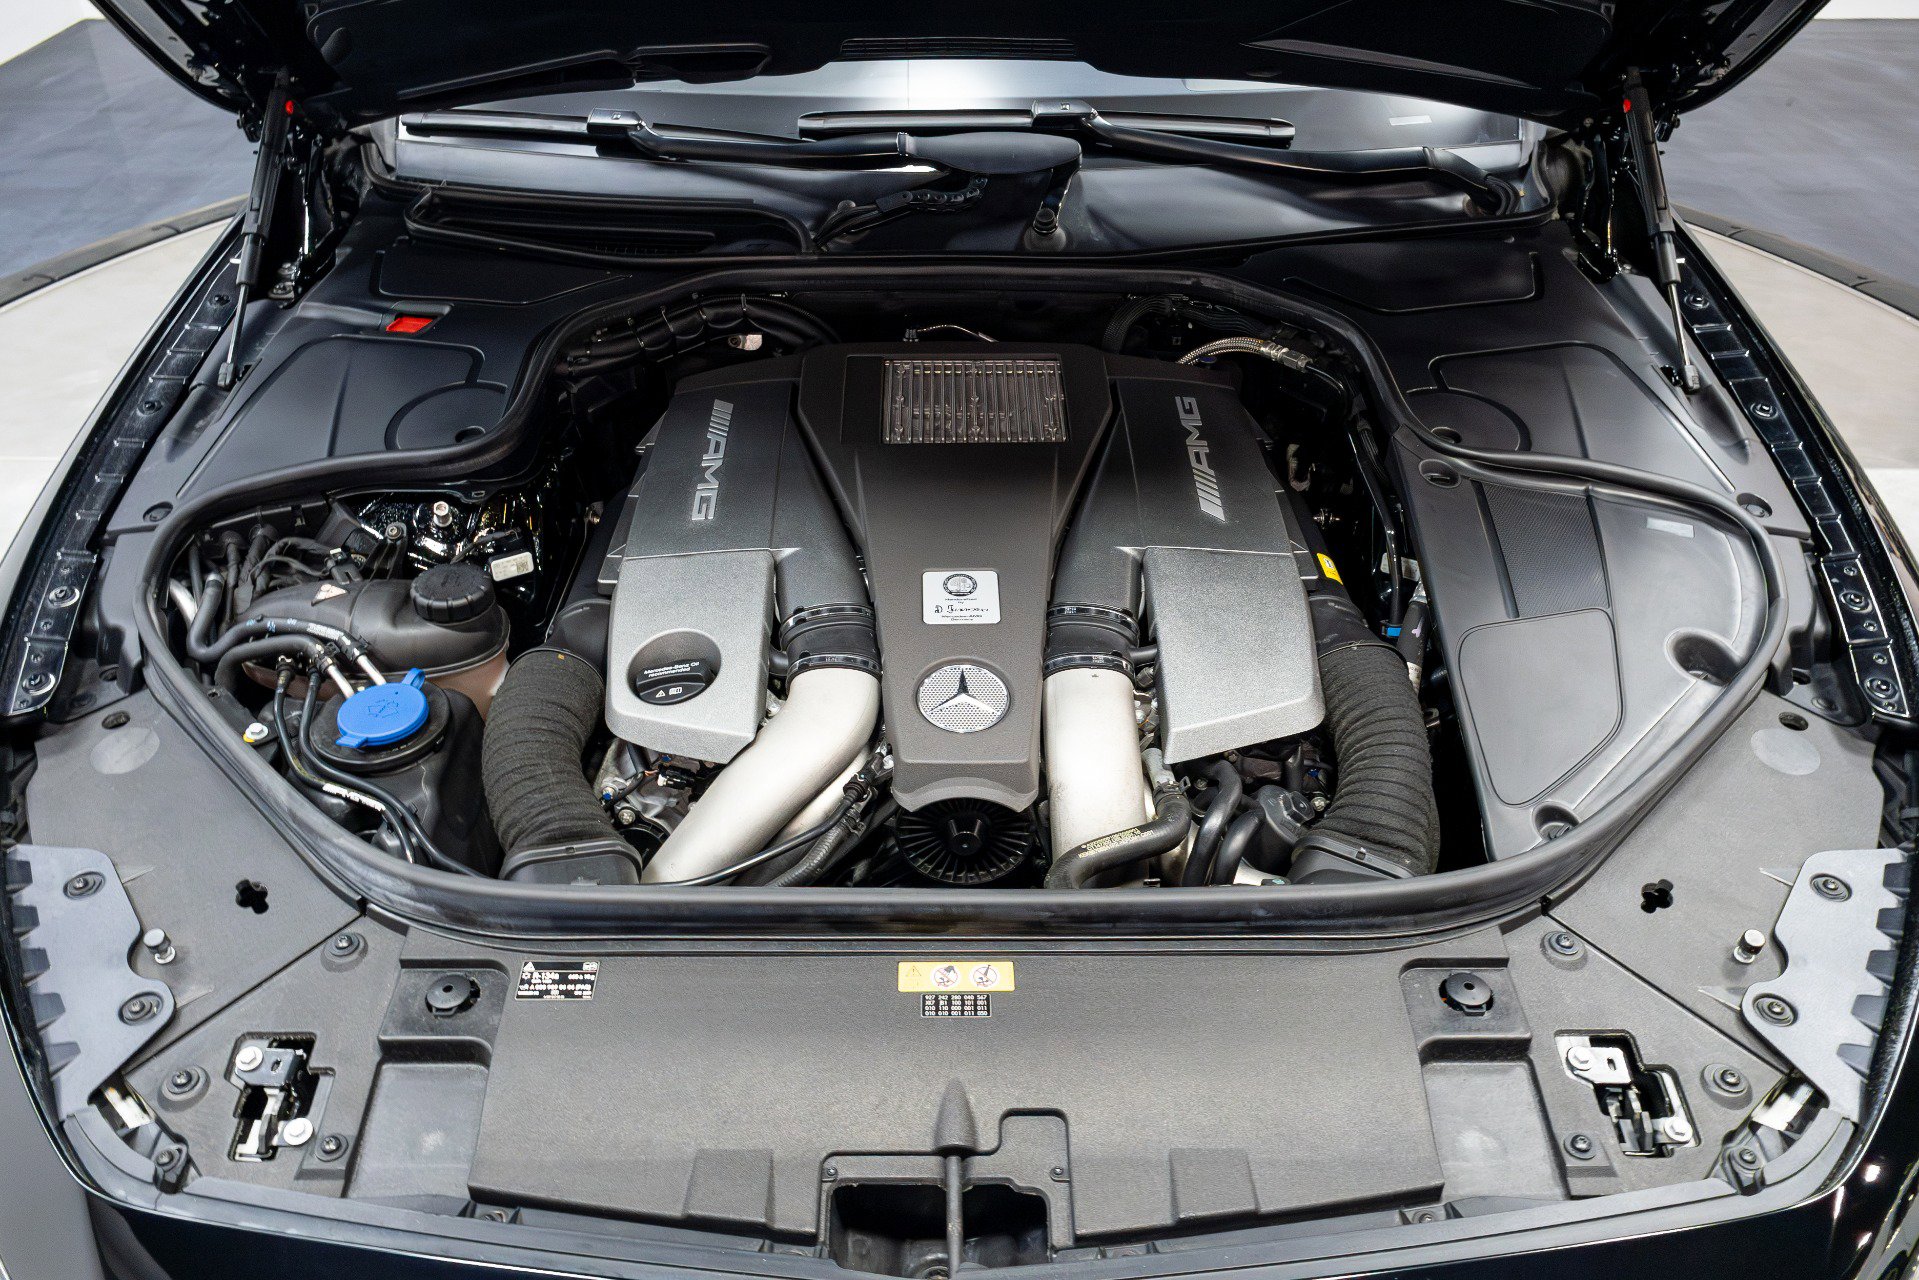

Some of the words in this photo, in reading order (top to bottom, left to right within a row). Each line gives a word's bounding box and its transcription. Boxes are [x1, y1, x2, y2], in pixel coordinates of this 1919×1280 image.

[691, 432, 727, 520] AMG
[1175, 396, 1216, 479] AMG
[648, 667, 690, 678] recommended
